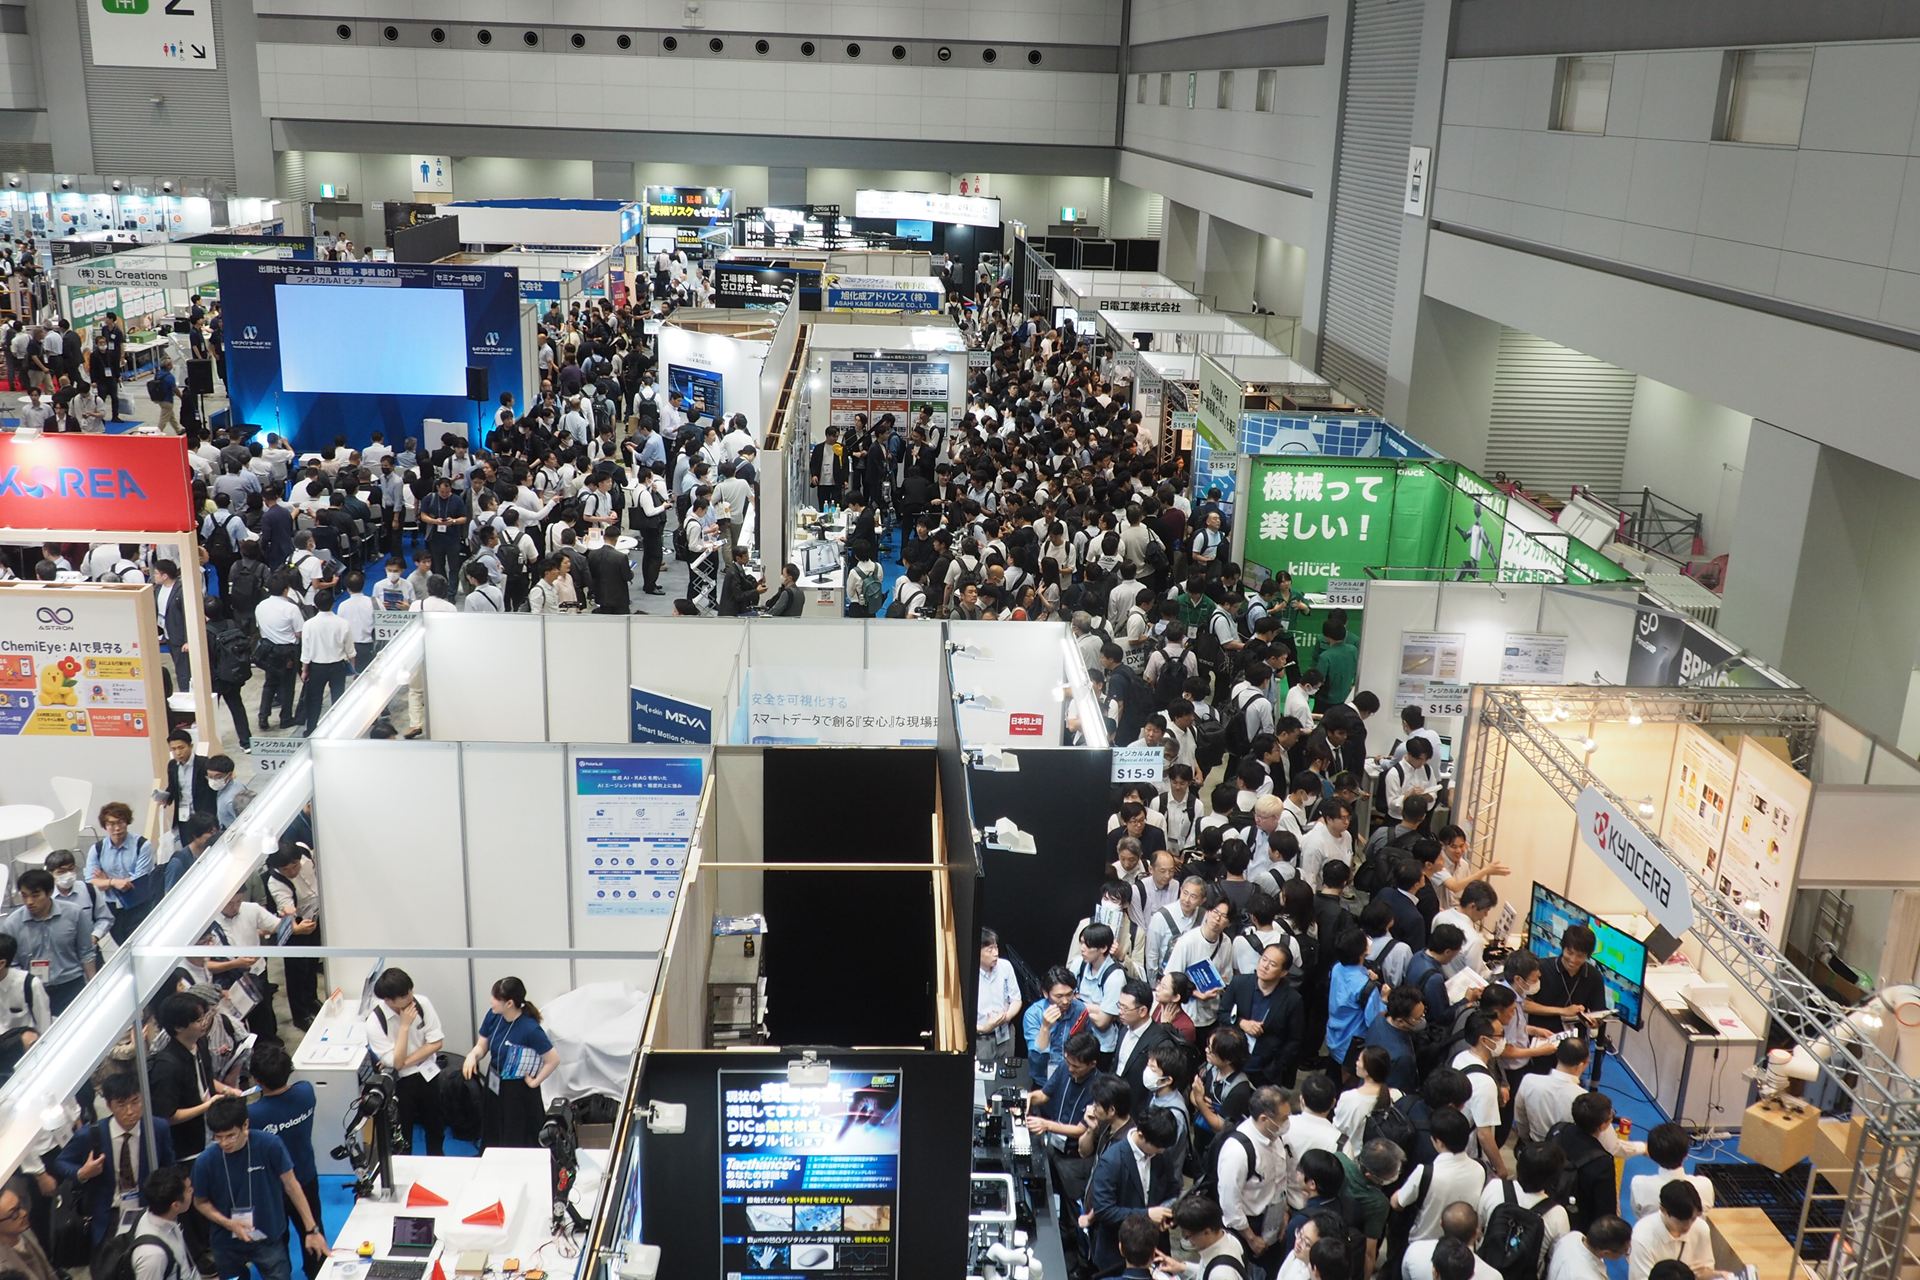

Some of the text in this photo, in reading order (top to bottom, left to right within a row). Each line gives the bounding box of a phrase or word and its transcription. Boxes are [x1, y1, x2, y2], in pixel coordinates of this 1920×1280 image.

[97, 270, 112, 279] SL
[114, 270, 168, 281] Creations
[1100, 300, 1182, 313] 日電工業株式会社
[970, 361, 989, 369] S15-21
[1263, 472, 1383, 503] 機械って
[1259, 511, 1371, 541] 楽しい！
[1288, 561, 1341, 577] kiluck
[1328, 595, 1363, 604] S15-10
[1428, 687, 1469, 695] フィジカルAI展
[752, 693, 849, 709] 安全を可視化する
[1429, 703, 1463, 714] S15-6
[637, 723, 656, 736] Smart
[657, 730, 679, 743] Motion
[1113, 750, 1161, 758] フィジカルAI展
[1117, 768, 1155, 779] S15-9
[1608, 824, 1671, 909] KYOCERA
